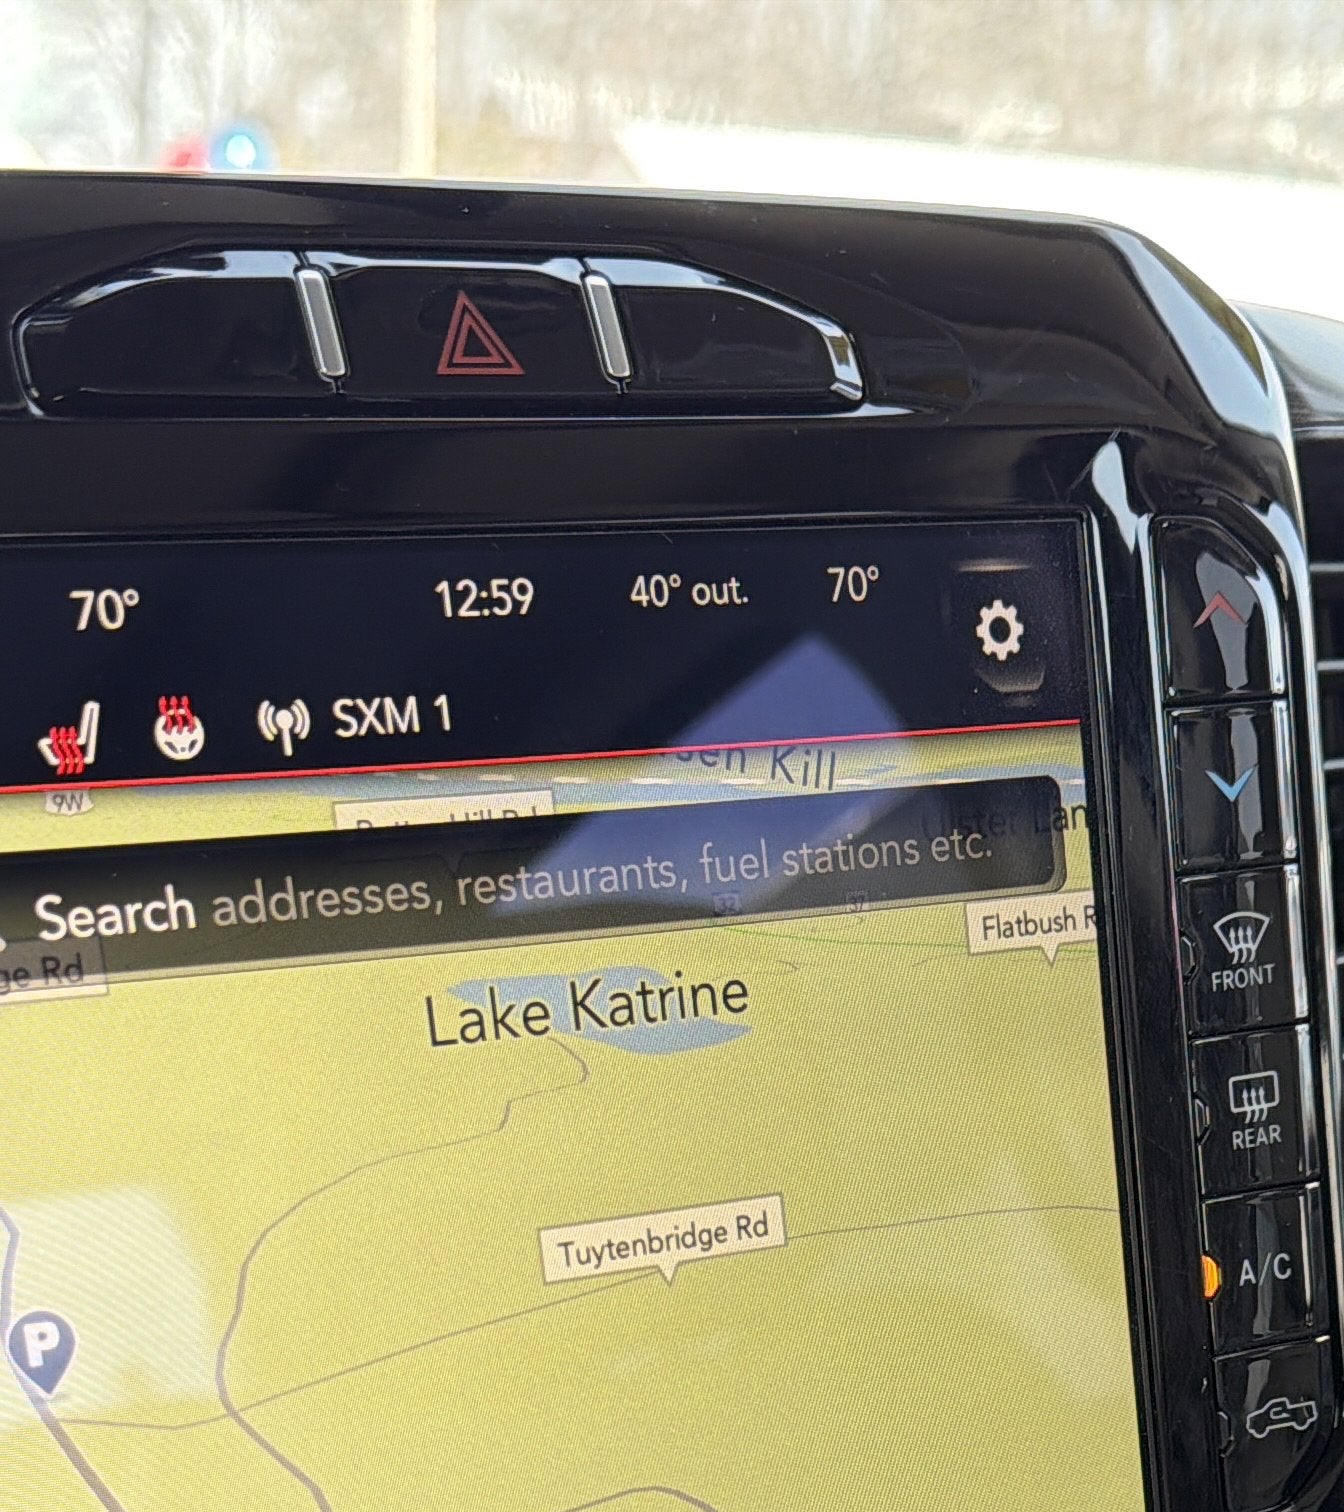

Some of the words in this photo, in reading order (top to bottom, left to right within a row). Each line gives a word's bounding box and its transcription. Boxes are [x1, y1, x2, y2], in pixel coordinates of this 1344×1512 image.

[434, 577, 535, 619] 12:59
[629, 573, 683, 608] 40°
[691, 575, 750, 607] out.
[826, 565, 880, 602] 70°
[69, 587, 140, 631] 70°
[332, 695, 421, 738] SXM
[434, 695, 452, 732] 1
[770, 746, 836, 791] Kill
[35, 886, 196, 941] Search
[212, 879, 444, 928] addresses,
[457, 856, 687, 905] restaurants,
[700, 836, 770, 886] fuel
[782, 829, 920, 877] stations
[931, 829, 992, 862] etc.
[982, 906, 1077, 941] Flatbush
[41, 952, 84, 985] Rd
[1211, 964, 1276, 993] FRONT
[423, 986, 551, 1048] Lake
[568, 972, 750, 1032] Katrine
[1232, 1124, 1282, 1150] REAR
[558, 1221, 729, 1271] Tuytenbridge
[736, 1211, 770, 1239] Rd
[1238, 1250, 1293, 1288] A/C
